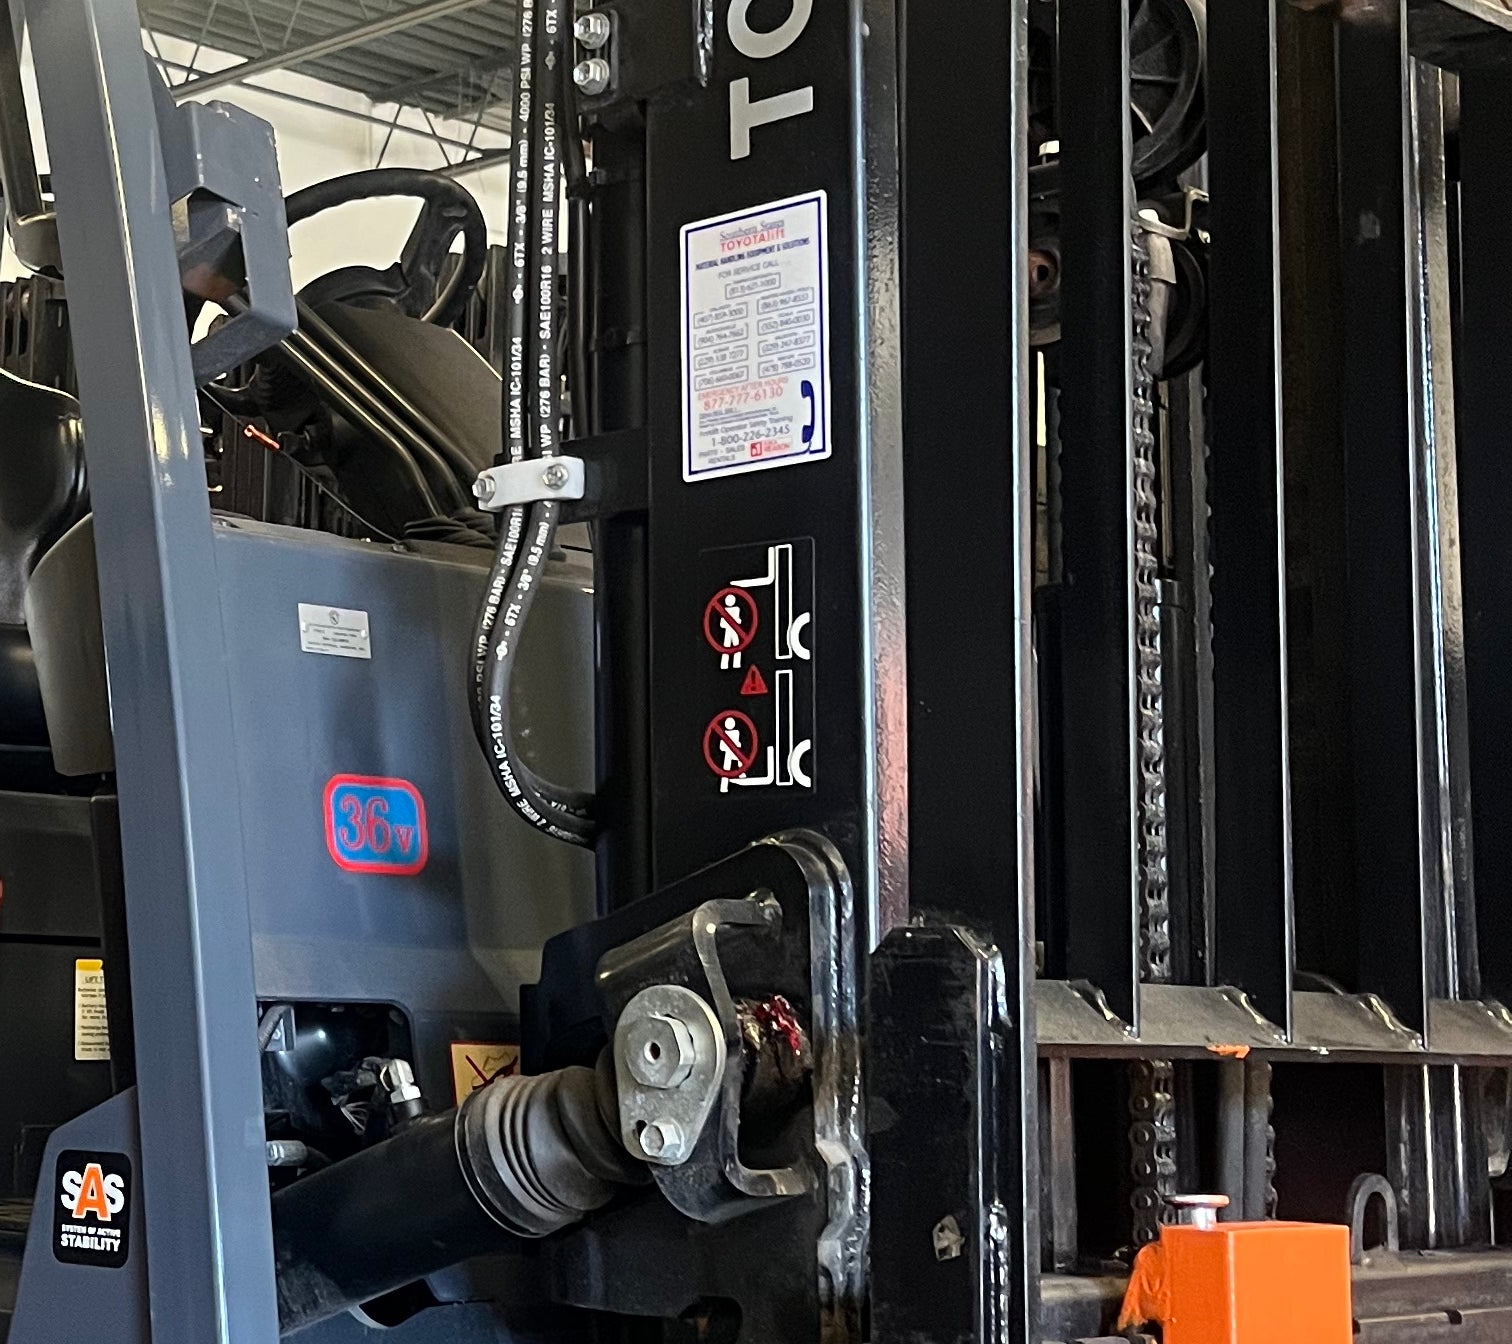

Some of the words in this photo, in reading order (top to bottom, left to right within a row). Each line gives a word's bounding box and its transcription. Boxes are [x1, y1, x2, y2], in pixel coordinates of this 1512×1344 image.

[545, 9, 558, 34] 6TX
[520, 43, 532, 65] WP
[520, 67, 531, 89] PSI
[519, 92, 531, 122] 4000
[544, 102, 556, 160] IC-101/34
[542, 163, 555, 202] MSHA
[541, 209, 553, 244] WIRE
[514, 242, 525, 268] 6TX
[541, 246, 553, 255] 2
[539, 265, 552, 340] SAE100R16
[509, 337, 522, 395] IC-101/34
[538, 354, 551, 388] BAR)
[538, 390, 551, 419] (276
[703, 385, 783, 411] 877-777-6130
[509, 398, 522, 438] MSHA
[539, 424, 552, 448] WP
[711, 423, 790, 447] 1-800-226-2345
[510, 446, 522, 463] RE
[535, 521, 550, 547] mm)
[488, 576, 506, 605] BAR)
[504, 602, 522, 627] 6TX
[490, 695, 507, 759] IC-101/34
[498, 760, 522, 797] MSHA
[60, 1163, 125, 1221] SAS
[60, 1233, 121, 1252] STABILITY
